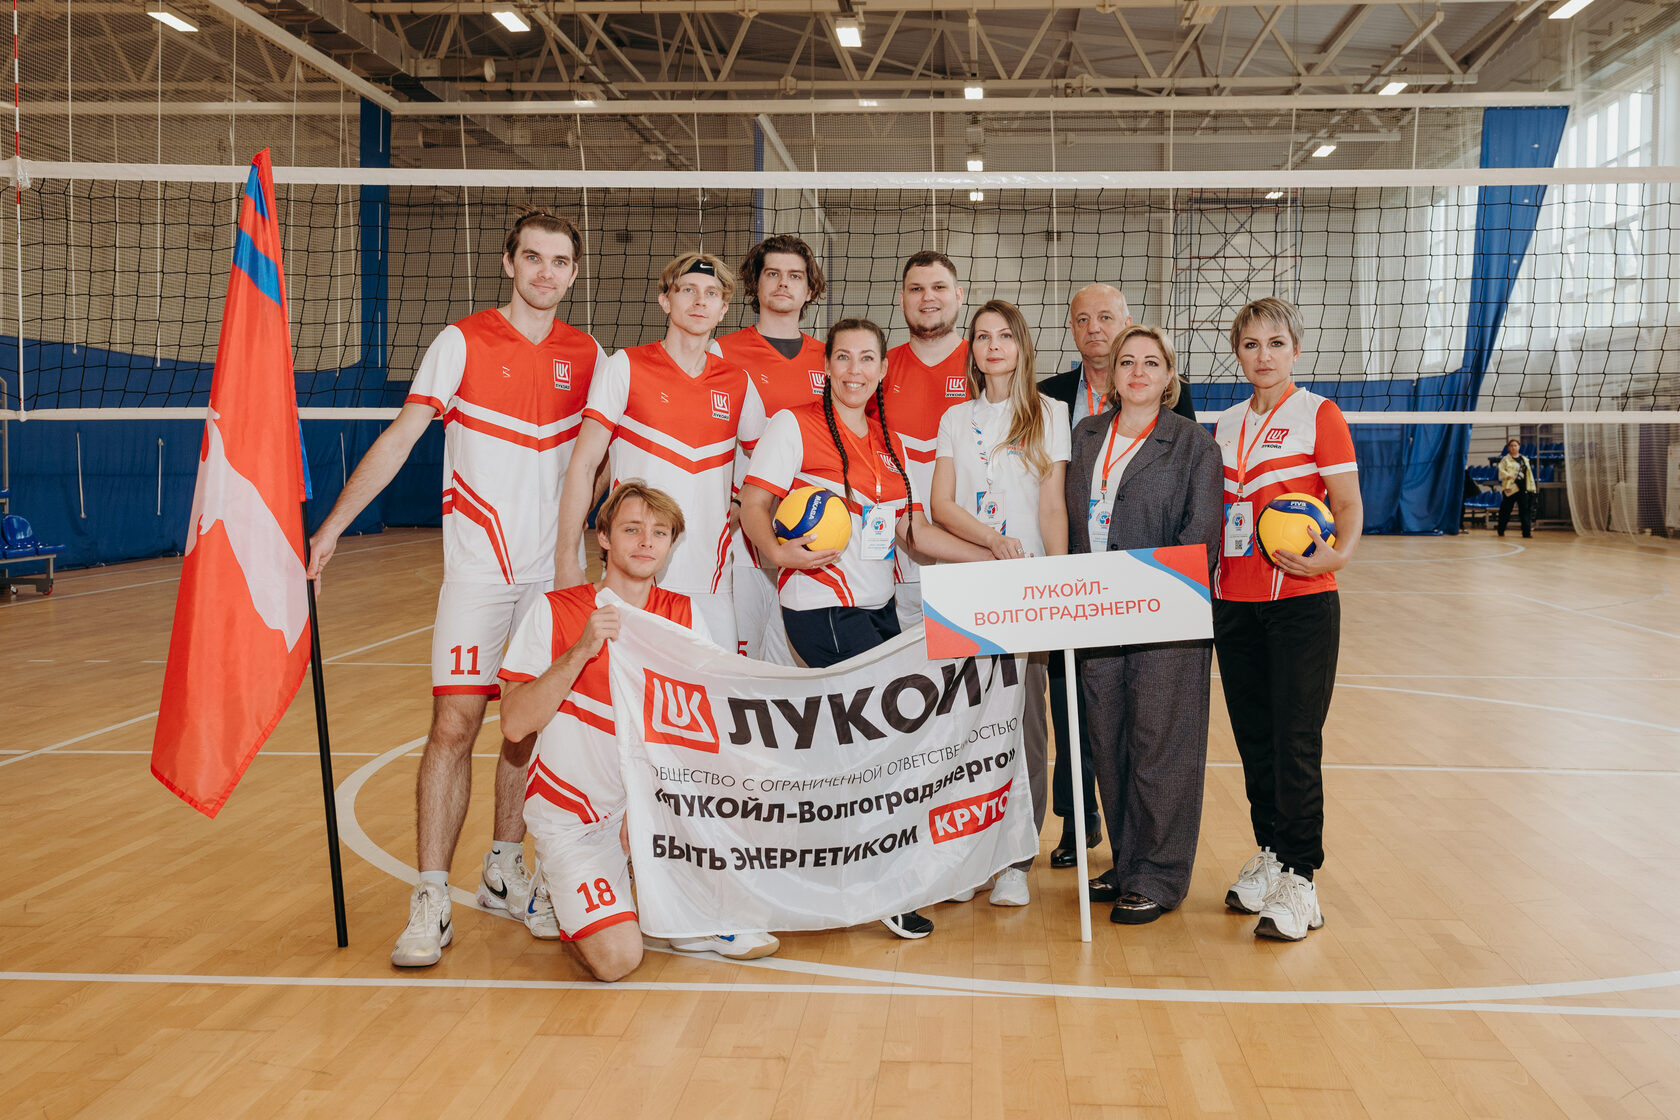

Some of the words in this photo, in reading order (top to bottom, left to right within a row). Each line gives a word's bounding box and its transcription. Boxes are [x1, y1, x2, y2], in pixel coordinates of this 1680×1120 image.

[1022, 578, 1109, 601] ЛУКОЙЛ-
[974, 598, 1161, 626] ВОЛГОГРАДЭНЕРГО
[450, 645, 481, 676] 11
[742, 778, 755, 791] С
[760, 764, 882, 792] ОГРАНИЧЕННОЙ
[887, 717, 1018, 776] ОТВЕТСТВЕОСТЬЮ
[652, 834, 727, 871] БЫТЬ
[730, 824, 919, 871] ЭНЕРГЕТИКОМ
[576, 877, 617, 914] 18
